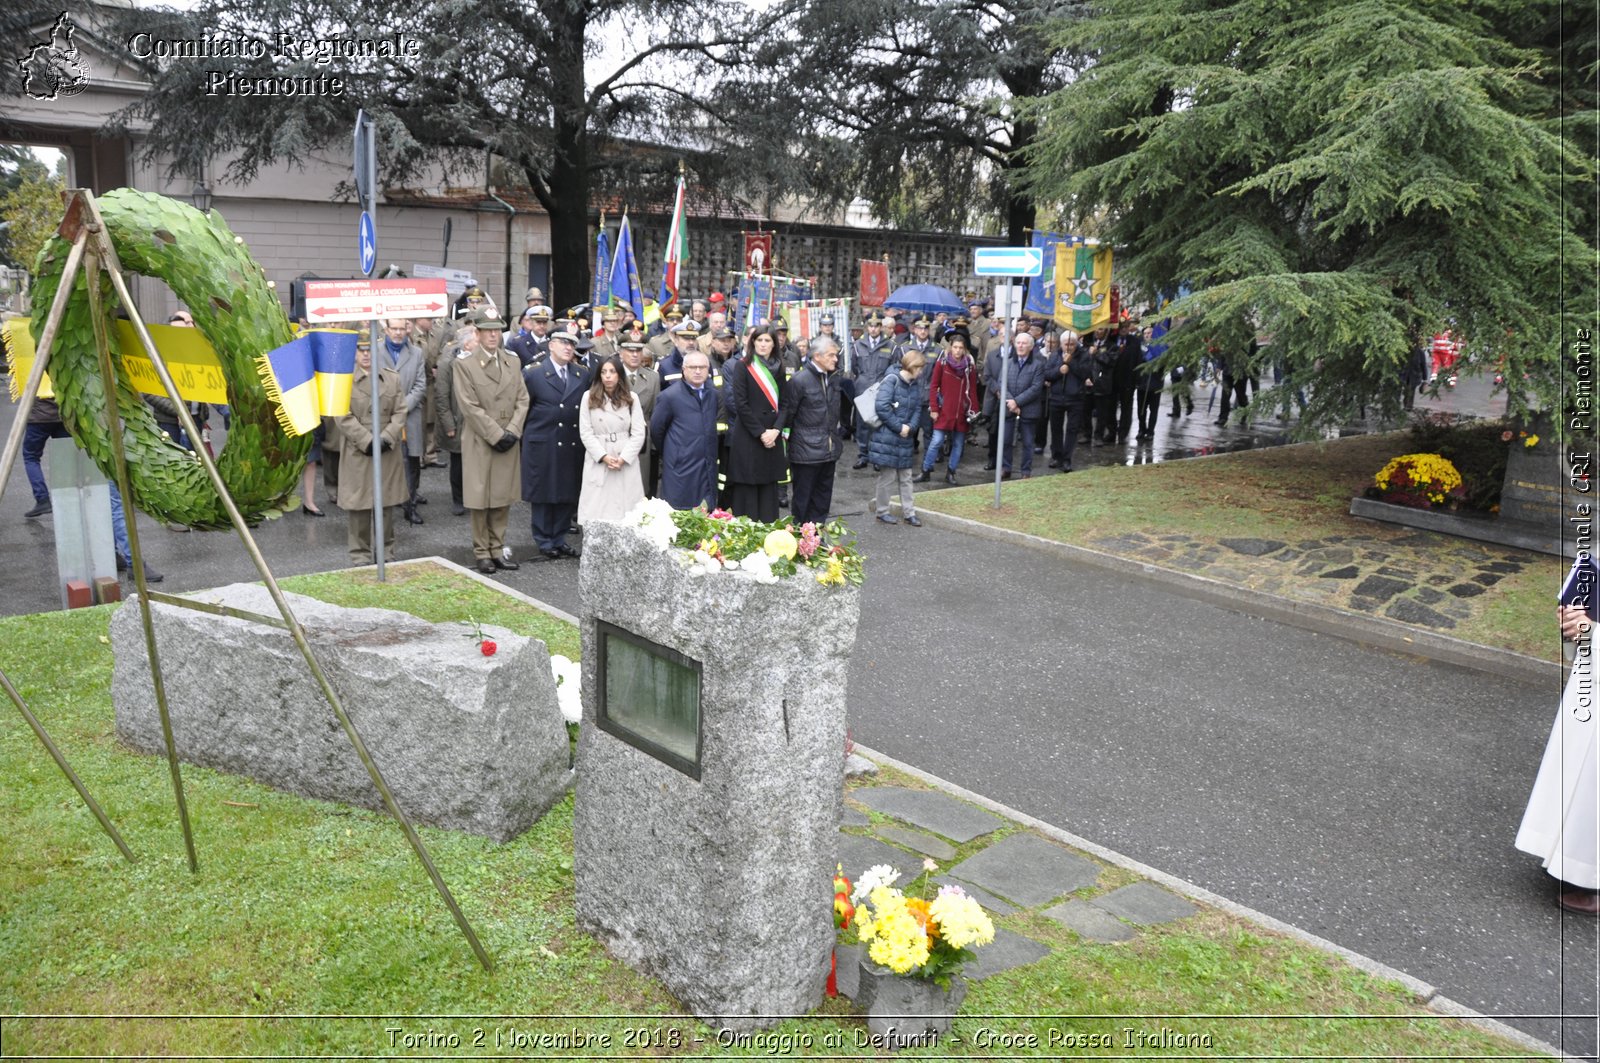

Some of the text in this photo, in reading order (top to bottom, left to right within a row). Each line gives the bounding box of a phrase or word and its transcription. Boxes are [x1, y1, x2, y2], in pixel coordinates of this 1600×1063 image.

[334, 281, 371, 289] MONUMENTALE
[340, 289, 359, 297] VIALE
[380, 288, 417, 296] CONSOLATA
